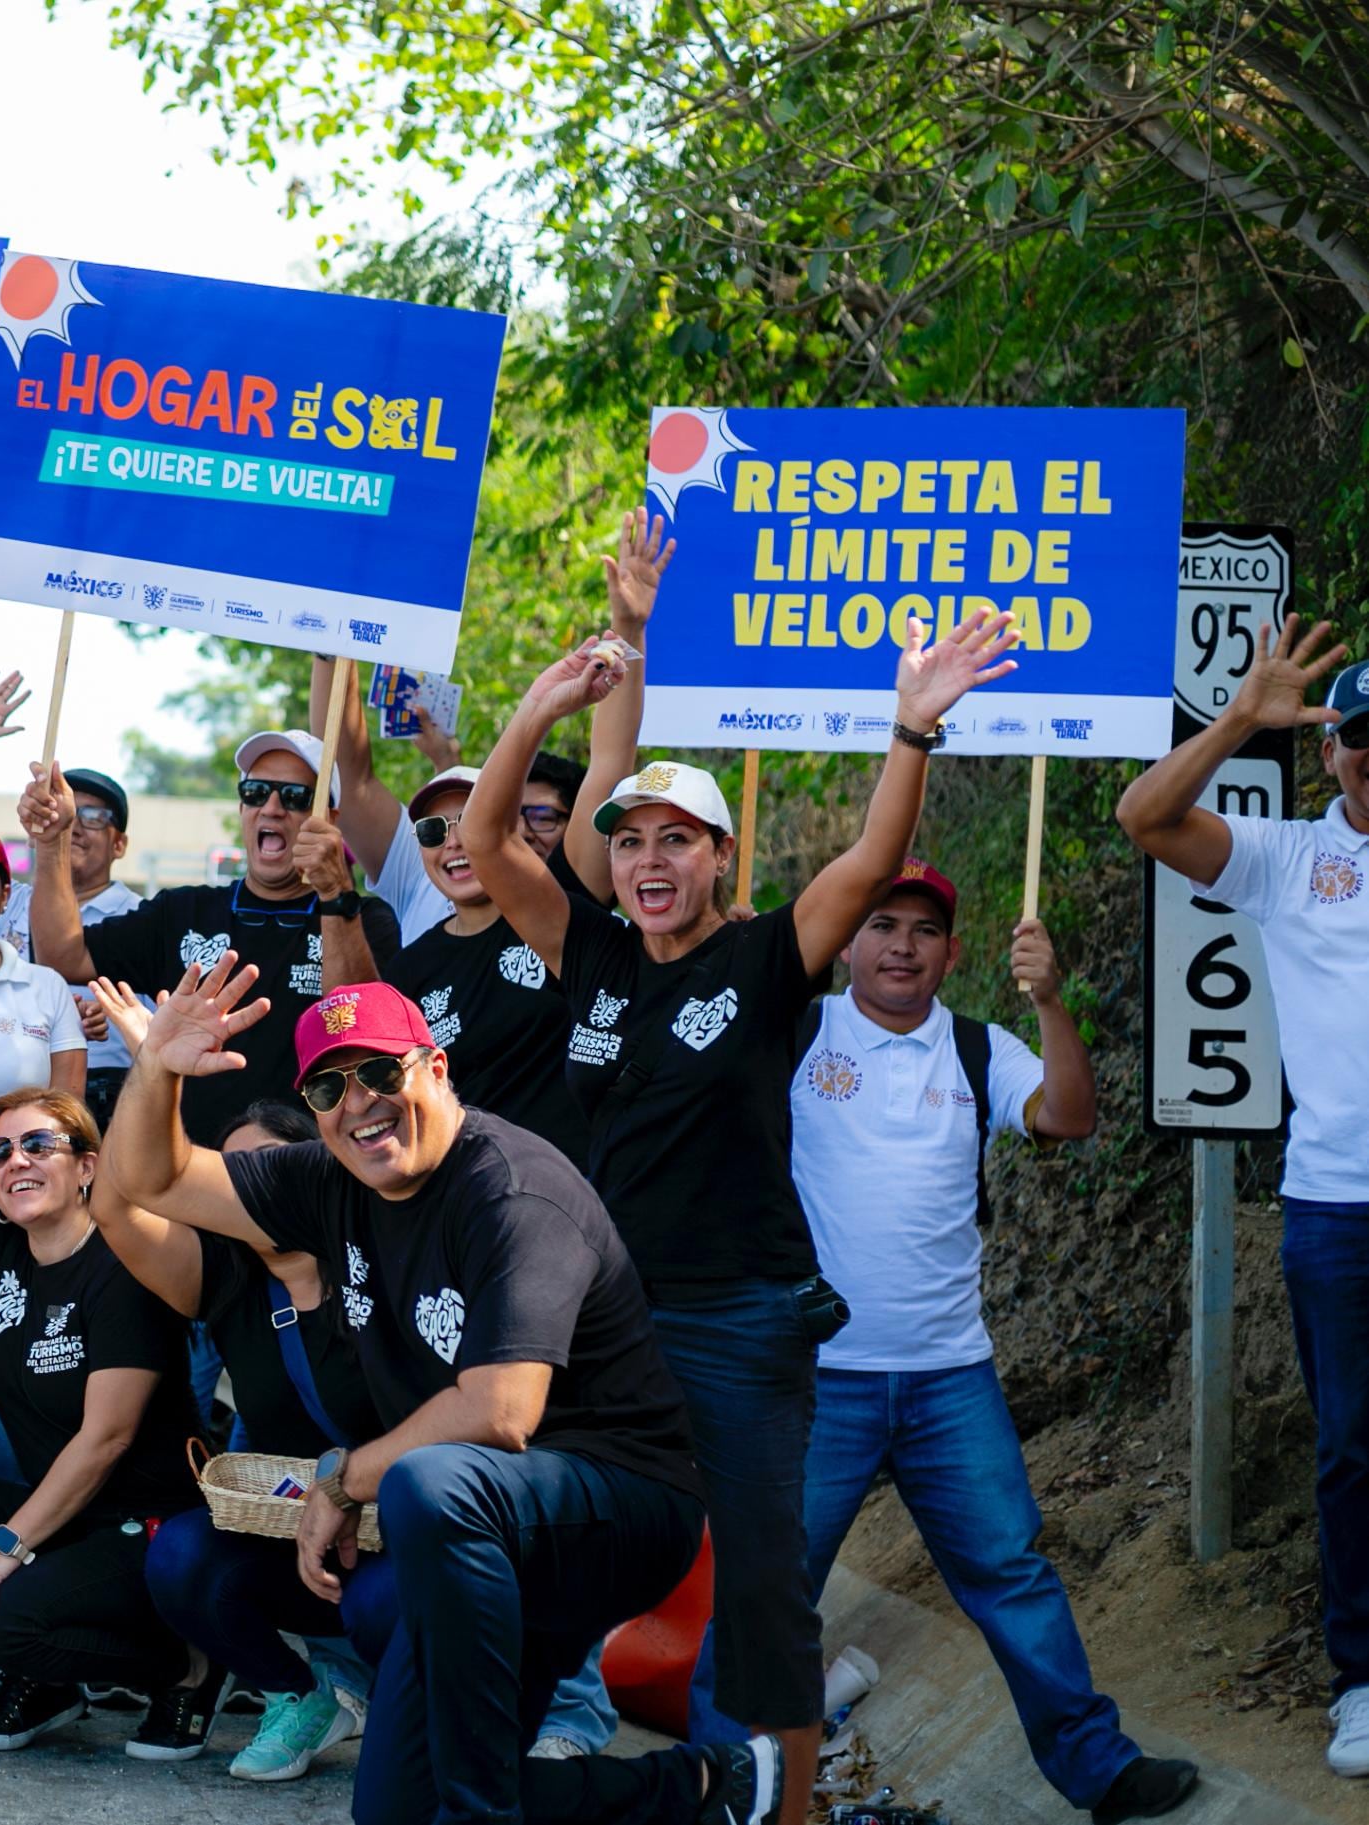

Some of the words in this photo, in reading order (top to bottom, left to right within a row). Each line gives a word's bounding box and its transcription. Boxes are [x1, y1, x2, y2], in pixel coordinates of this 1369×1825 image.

[17, 379, 50, 410] EL
[57, 352, 278, 438] HOGAR
[288, 382, 322, 440] DEL
[54, 441, 101, 477] ¡TE
[108, 446, 215, 486] QUIERE
[221, 460, 260, 492] DE
[269, 465, 382, 507] VUELTA!
[733, 460, 1018, 513] RESPETA
[1042, 461, 1111, 514] EL
[754, 516, 965, 582] LÍMITE
[989, 529, 1070, 583] DE
[225, 605, 263, 618] TURISMO
[733, 593, 1092, 650] VELOCIDAD
[1191, 602, 1255, 678] 95
[291, 964, 322, 972] SECRETA
[291, 972, 322, 982] TURIS
[304, 981, 322, 989] ESTA
[297, 987, 322, 996] GUERR
[317, 992, 362, 1013] SECTUR
[29, 1341, 83, 1358] TURISMO
[26, 1359, 39, 1367] DEL
[40, 1355, 72, 1366] ESTADO
[73, 1351, 85, 1360] DE
[34, 1361, 79, 1374] GUERRERO
